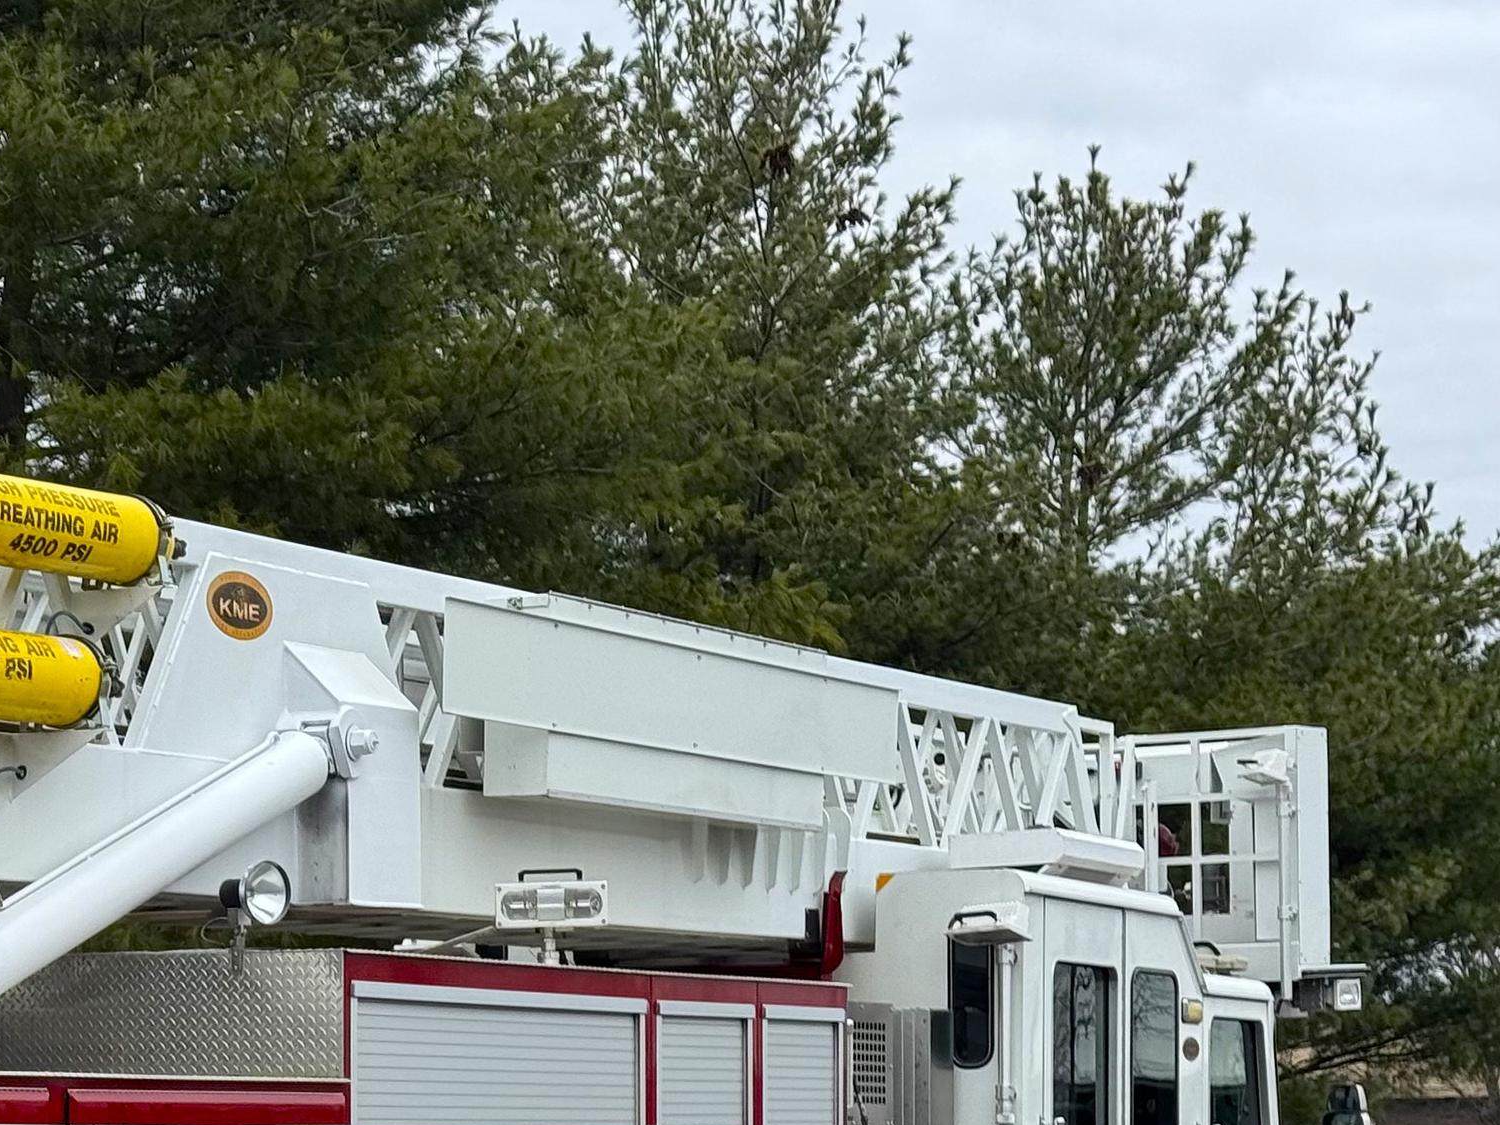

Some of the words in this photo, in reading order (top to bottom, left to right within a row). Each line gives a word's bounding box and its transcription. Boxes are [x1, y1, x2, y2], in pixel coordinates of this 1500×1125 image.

[26, 484, 120, 518] PRESSURE
[90, 521, 118, 545] AIR
[9, 533, 58, 557] 4500
[60, 542, 93, 562] PSI
[220, 597, 260, 622] KME
[26, 640, 56, 658] AIR
[5, 658, 33, 680] PSI
